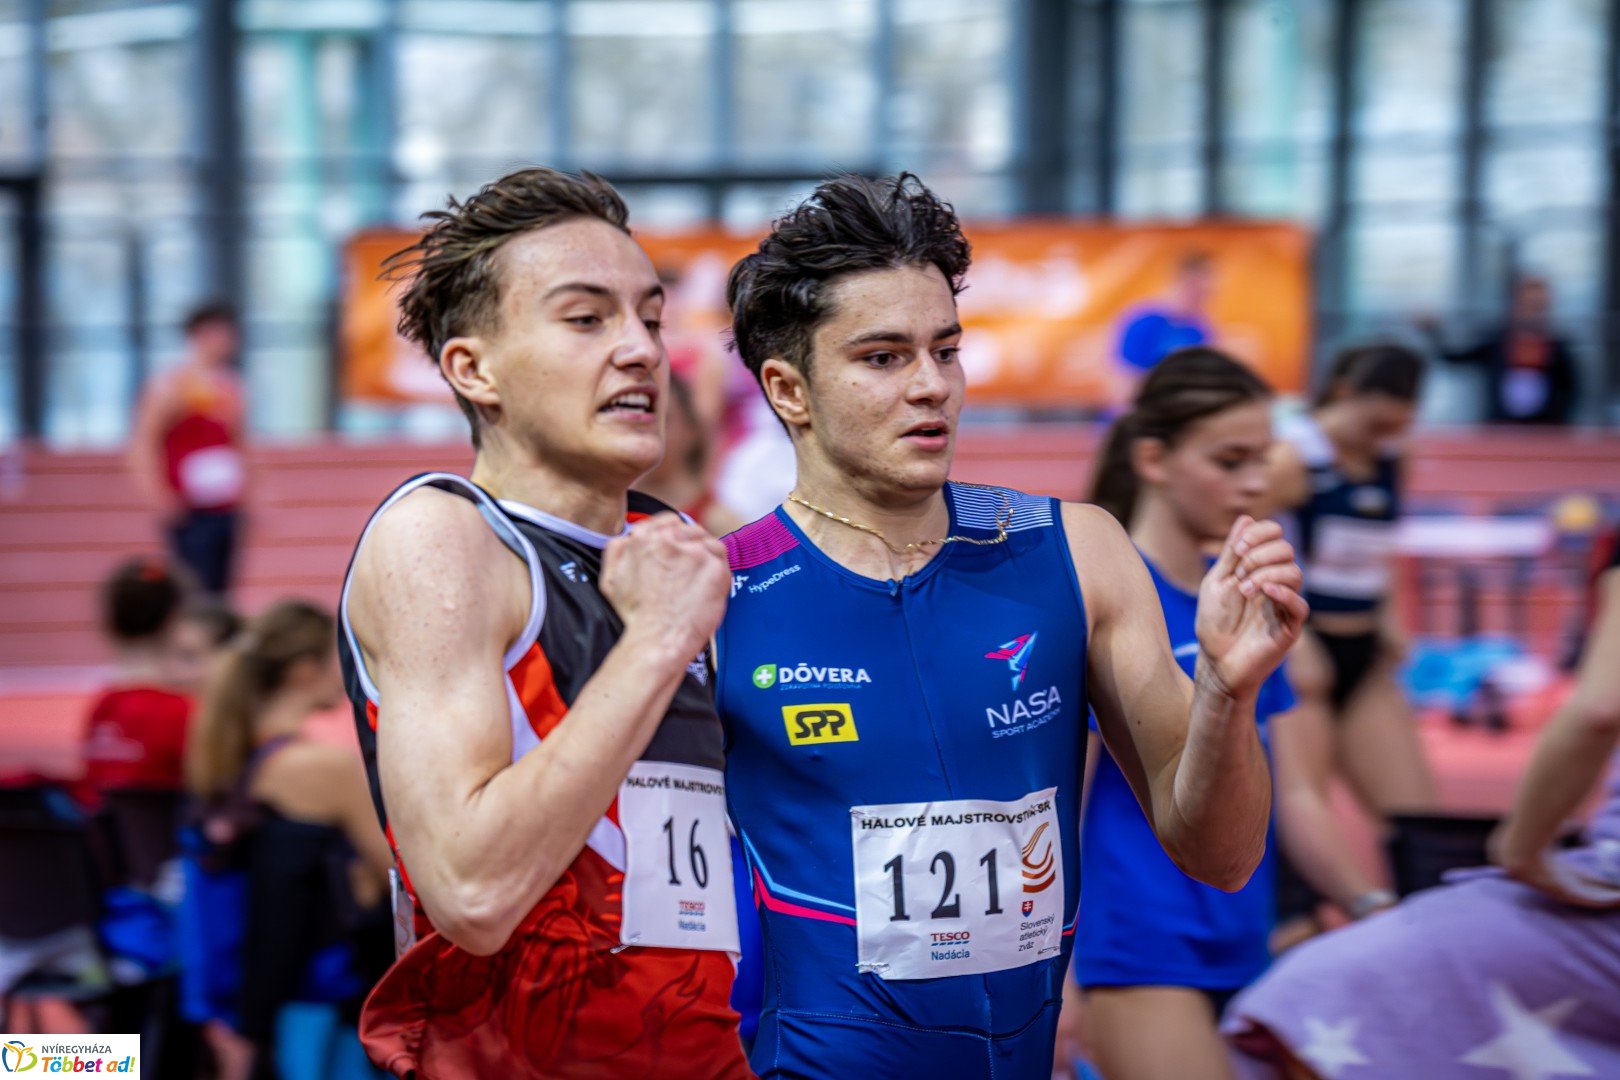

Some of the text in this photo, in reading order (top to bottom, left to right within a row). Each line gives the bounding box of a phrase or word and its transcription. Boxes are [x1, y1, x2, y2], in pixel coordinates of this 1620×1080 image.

[748, 564, 801, 594] HypeDress
[985, 685, 1062, 728] NASA
[794, 709, 846, 739] SPP
[991, 725, 1025, 739] SPORT
[861, 815, 926, 830] HALOVÉ
[663, 815, 708, 889] 16
[883, 847, 1004, 922] 121
[1020, 912, 1055, 931] Slovenský
[930, 931, 970, 942] TESCO
[1019, 924, 1048, 942] atletický
[931, 950, 970, 961] Nadácia
